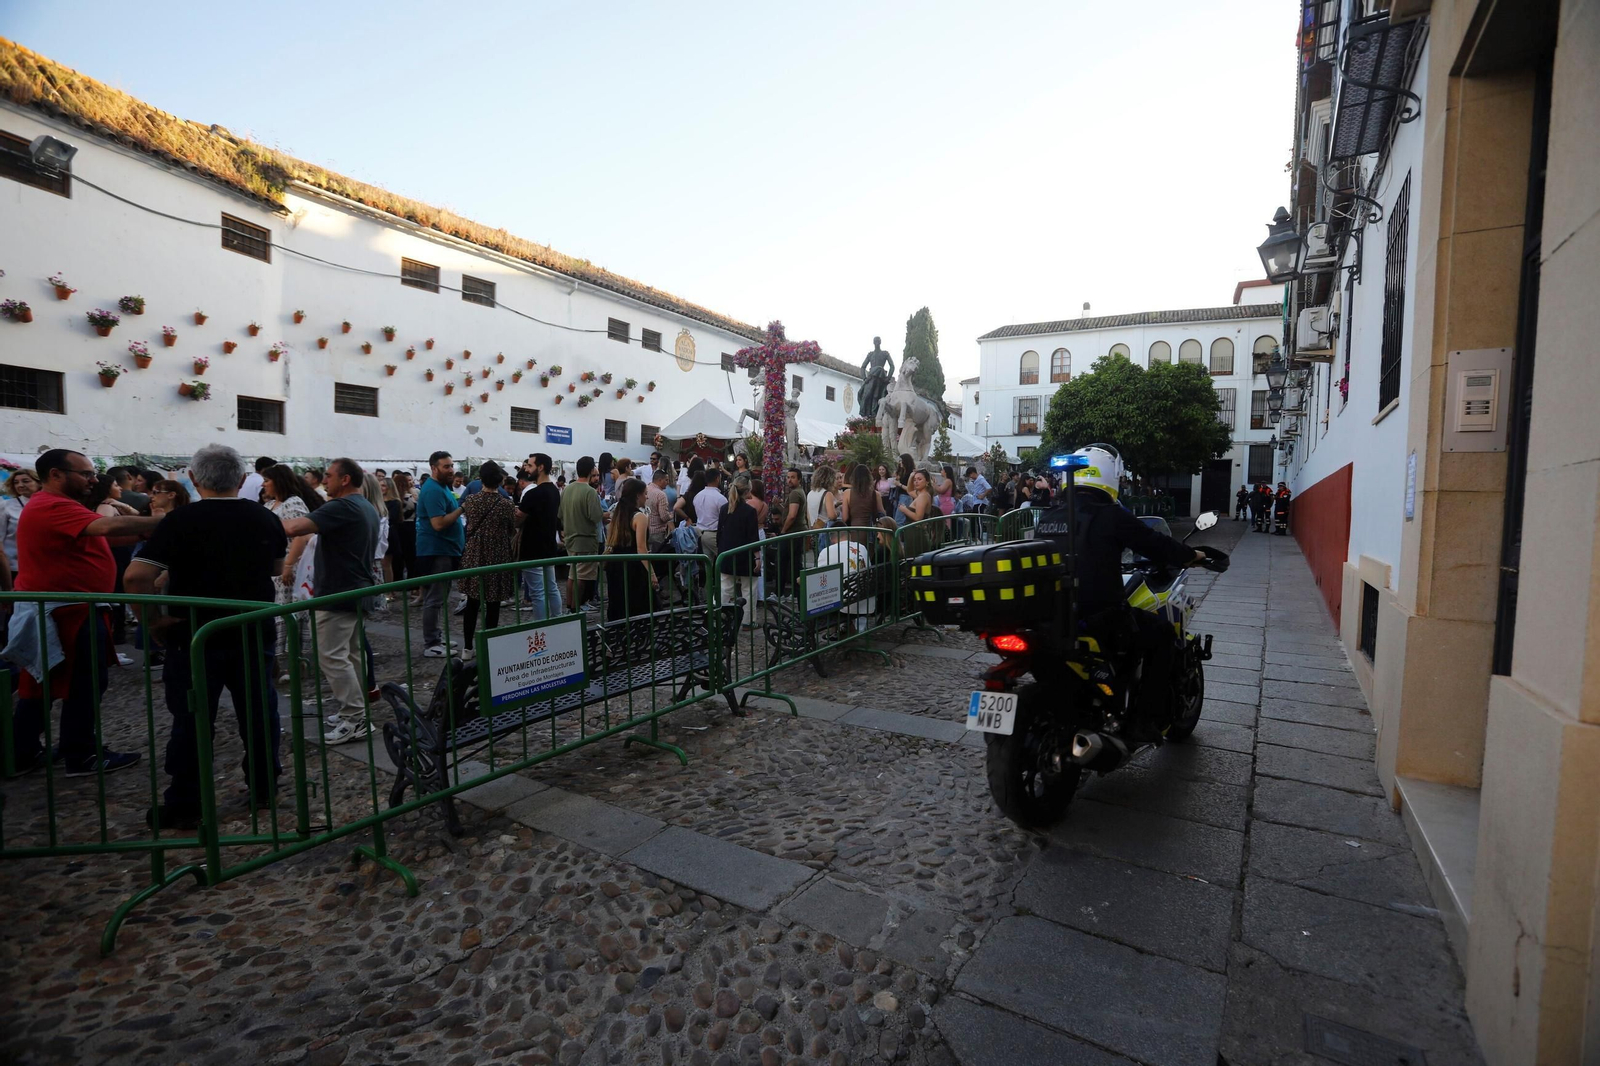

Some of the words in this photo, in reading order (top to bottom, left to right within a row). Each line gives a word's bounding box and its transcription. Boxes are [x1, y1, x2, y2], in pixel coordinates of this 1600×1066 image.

[1038, 521, 1058, 533] POLICÍA
[497, 659, 541, 676] AYUNTAMIENTO
[542, 656, 550, 665] DE
[550, 649, 578, 663] CÓRDOBA
[504, 674, 520, 683] Área
[521, 671, 530, 679] de
[530, 660, 576, 676] Infraestructuras
[517, 679, 535, 688] Equipo
[543, 671, 564, 680] Montajes
[501, 688, 530, 701] PERDONEN
[530, 685, 540, 694] LAS
[540, 678, 567, 690] MOLESTIAS
[980, 694, 1013, 713] 5200
[977, 710, 1002, 729] MWB
